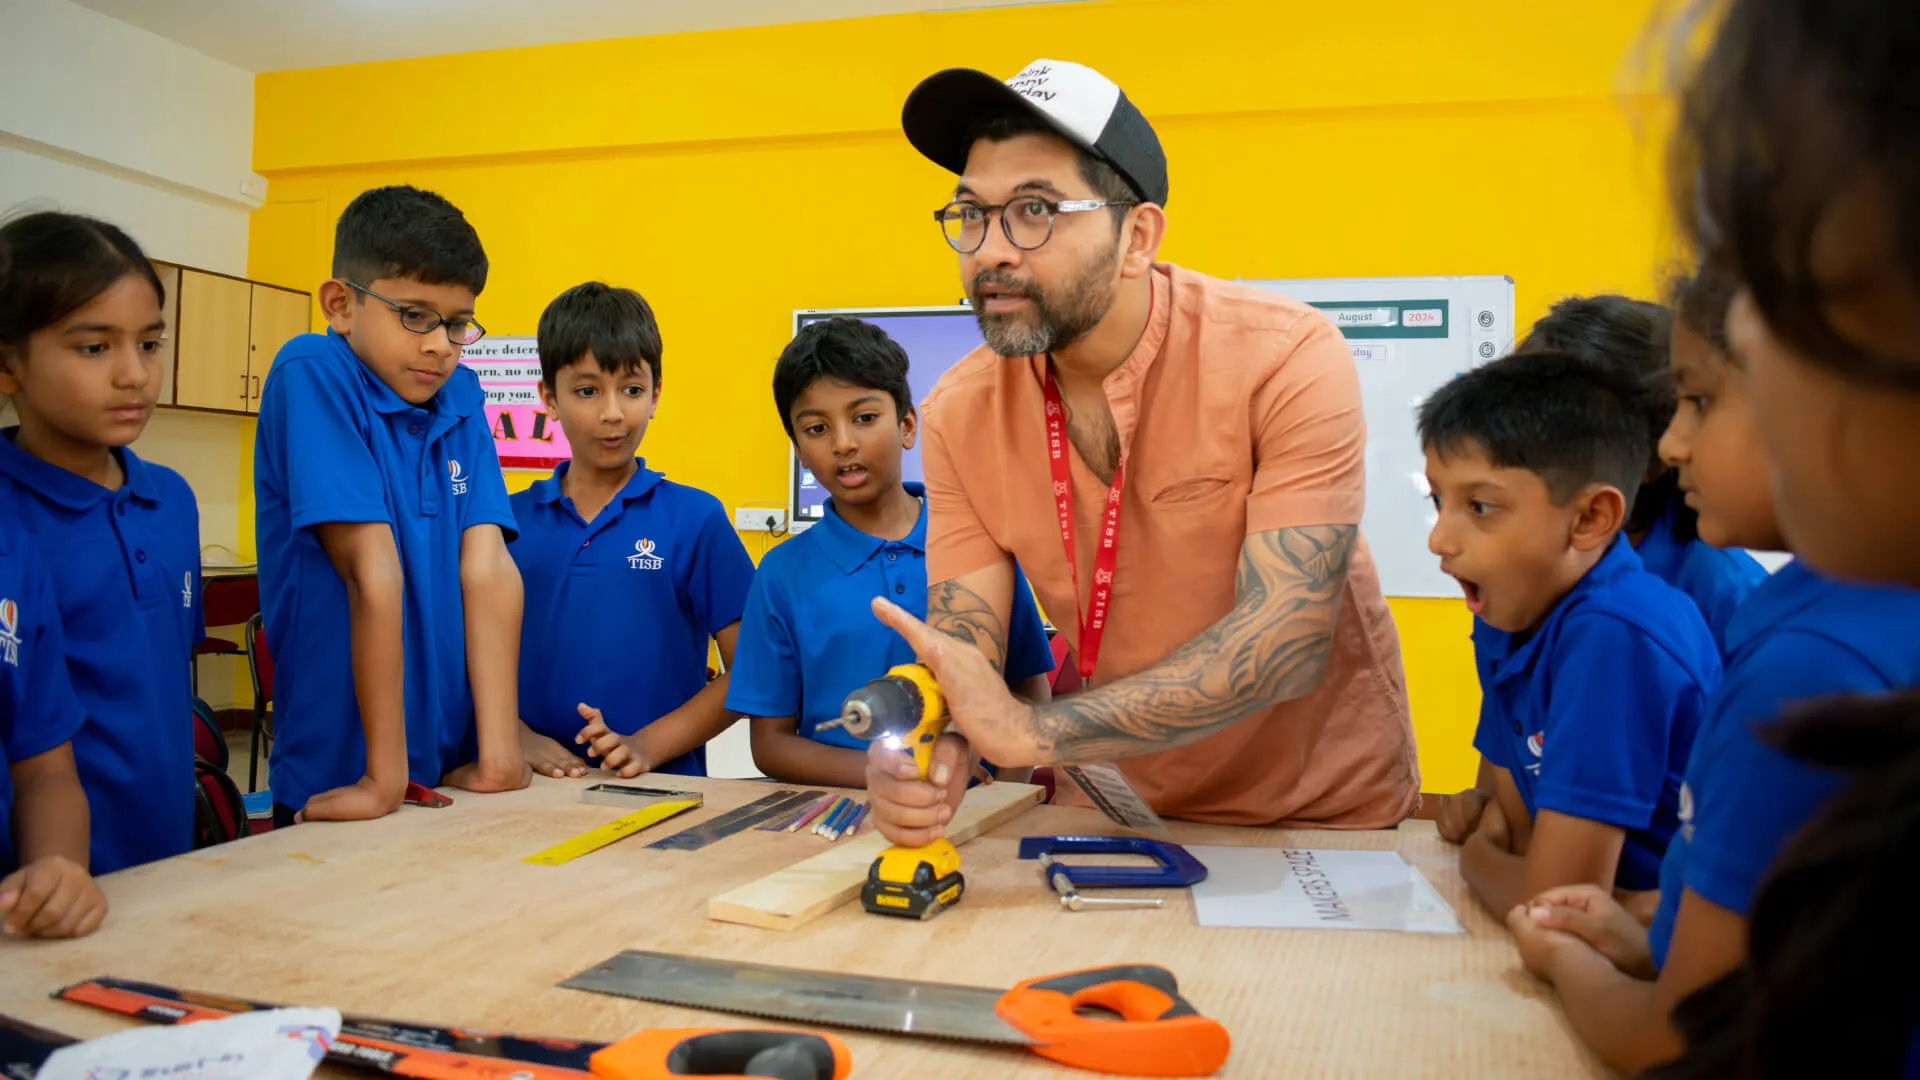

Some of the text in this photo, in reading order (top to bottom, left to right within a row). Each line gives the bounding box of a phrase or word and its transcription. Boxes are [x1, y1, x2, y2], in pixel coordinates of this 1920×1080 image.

[1017, 87, 1056, 101] day
[1338, 312, 1434, 323] August 2024
[460, 344, 540, 358] you're deter
[505, 369, 521, 377] no
[509, 391, 534, 402] you.
[1050, 420, 1062, 459] TISB
[628, 557, 662, 570] TISB
[1282, 850, 1353, 922] MAKERS SPACE
